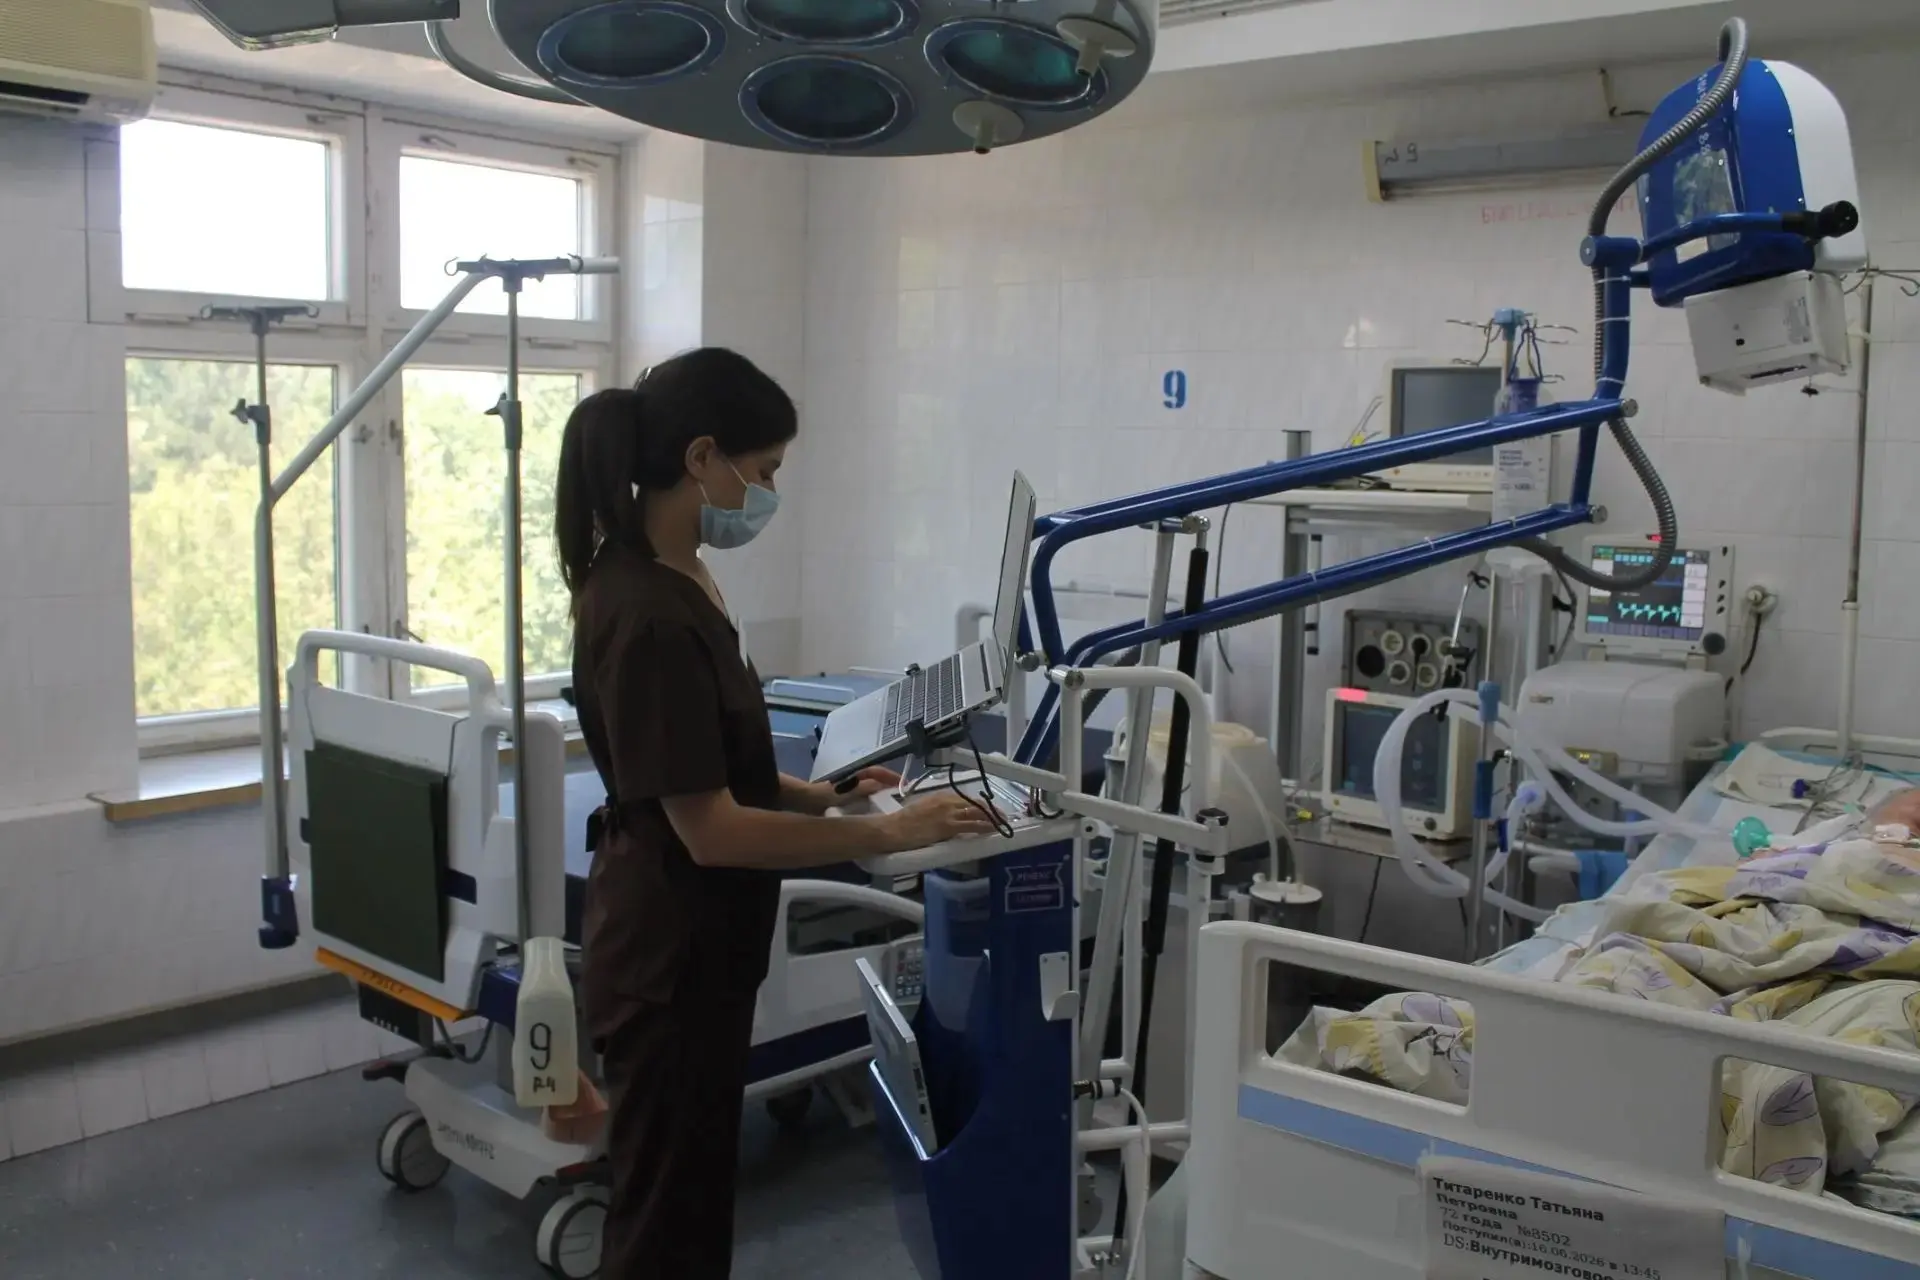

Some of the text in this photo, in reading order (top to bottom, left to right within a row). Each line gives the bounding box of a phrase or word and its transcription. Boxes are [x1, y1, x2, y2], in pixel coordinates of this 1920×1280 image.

[1163, 369, 1187, 409] 9
[529, 1022, 552, 1070] 9
[1433, 1176, 1604, 1222] Титаренко Татьяна
[1436, 1192, 1518, 1220] Петровна
[1440, 1206, 1571, 1247] 72 года №8502
